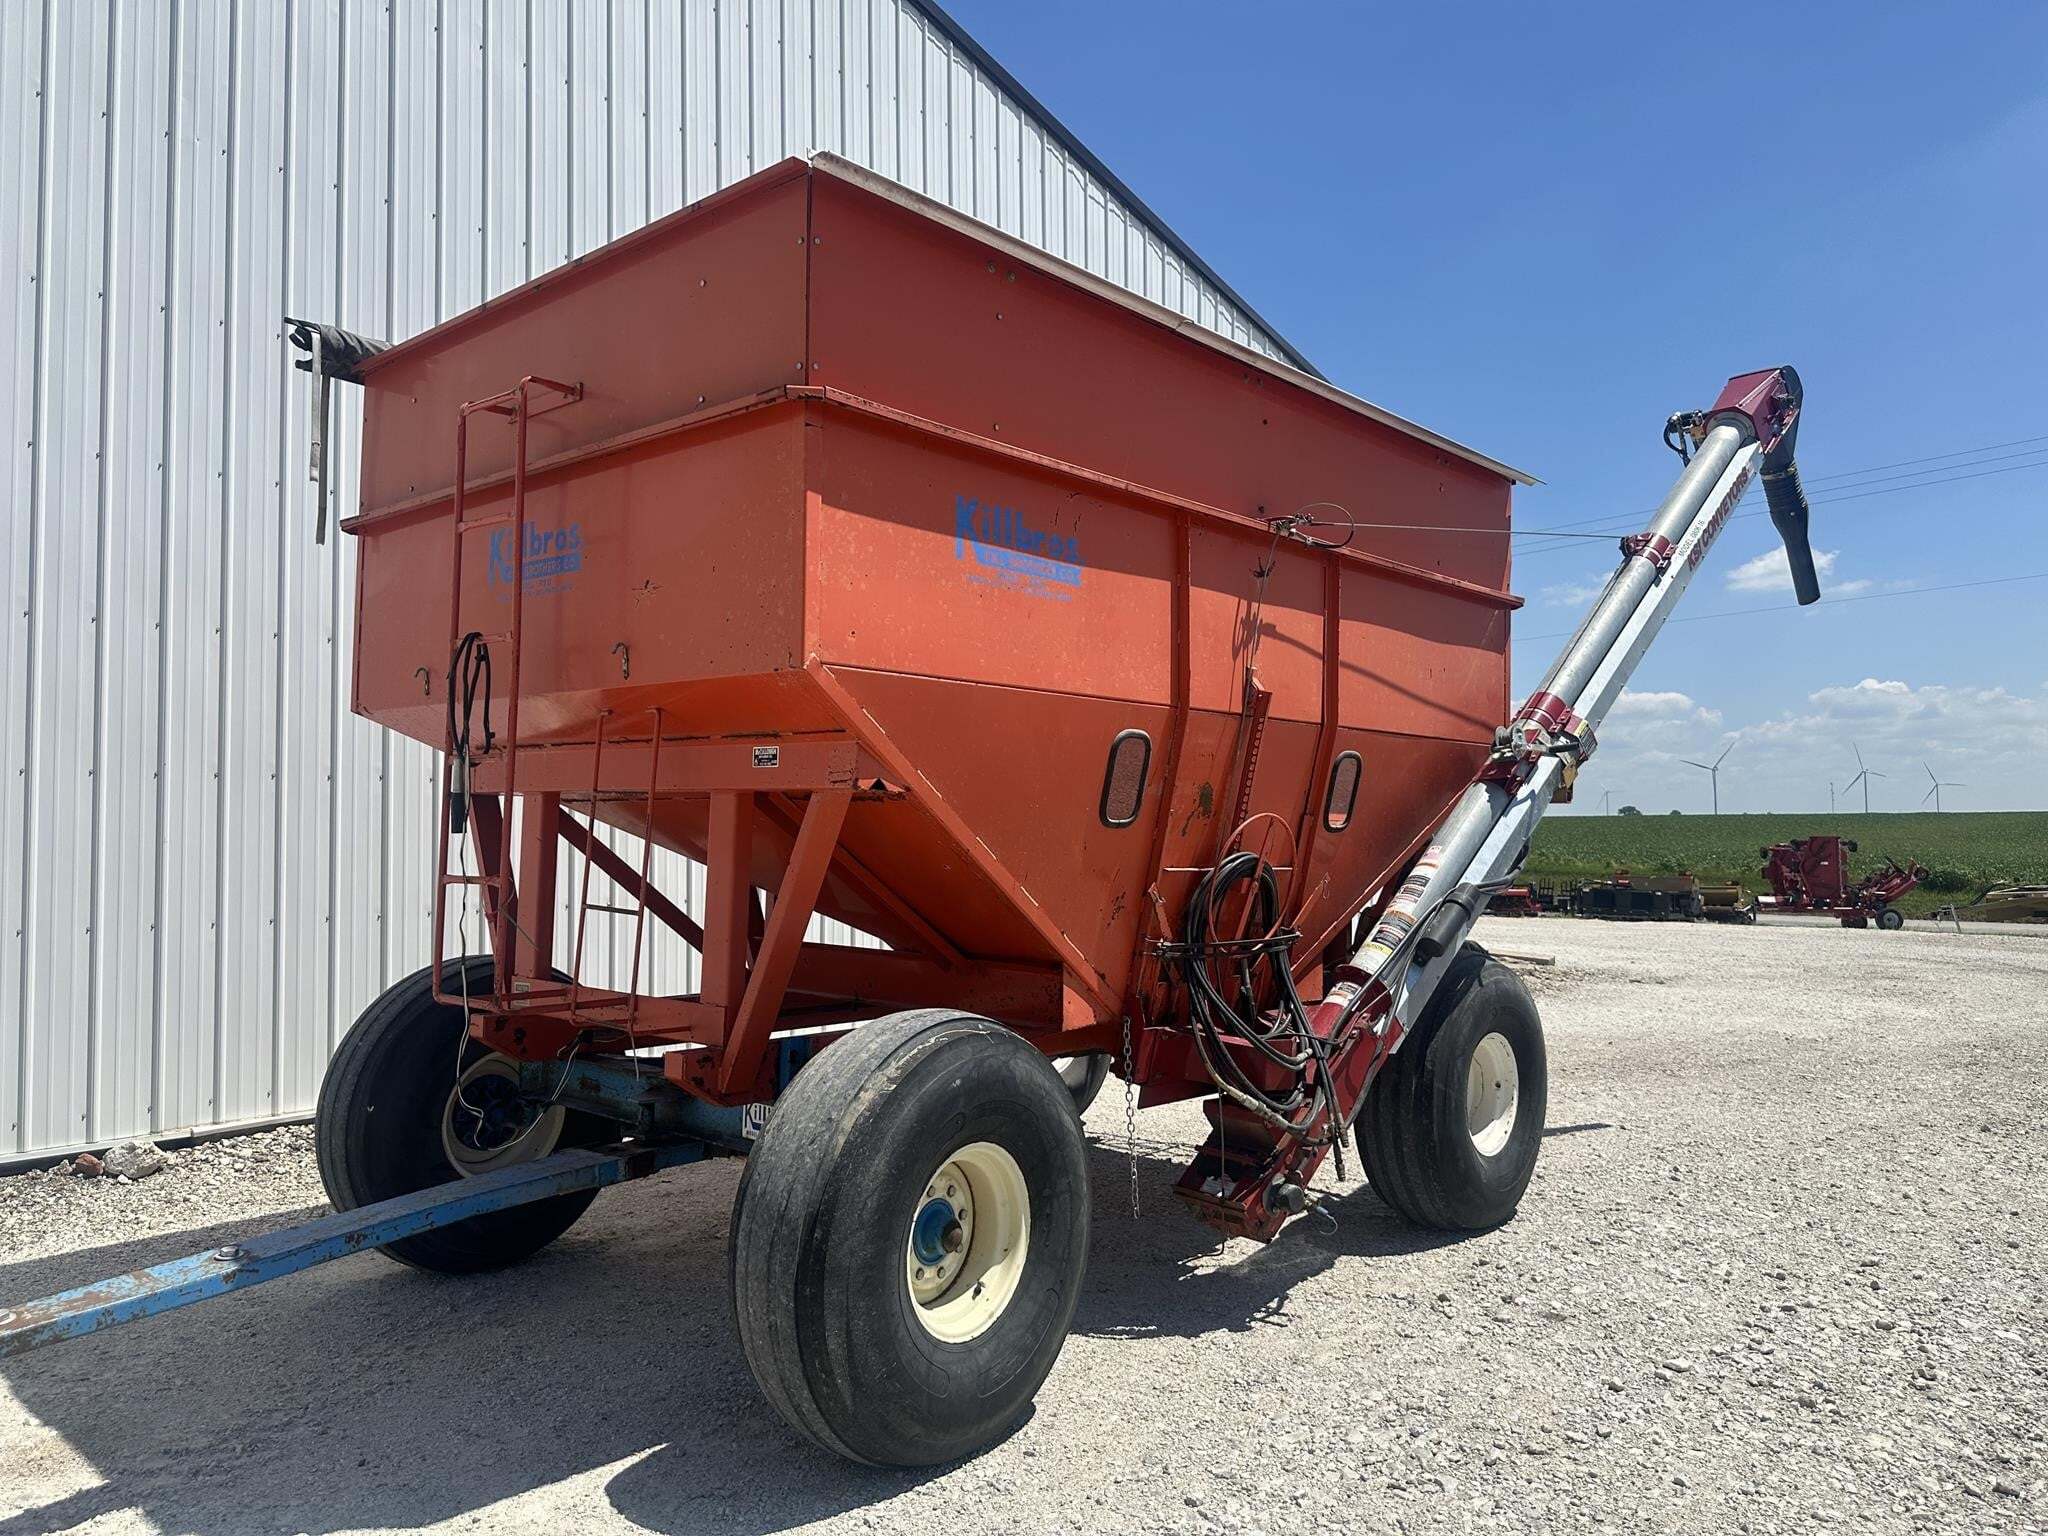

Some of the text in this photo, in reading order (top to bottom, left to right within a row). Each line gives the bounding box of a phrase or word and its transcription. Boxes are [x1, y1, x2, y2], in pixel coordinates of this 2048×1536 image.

[955, 494, 1080, 563] Killbros
[1700, 465, 1749, 548] CONVEYORS
[487, 521, 584, 592] Kilbros
